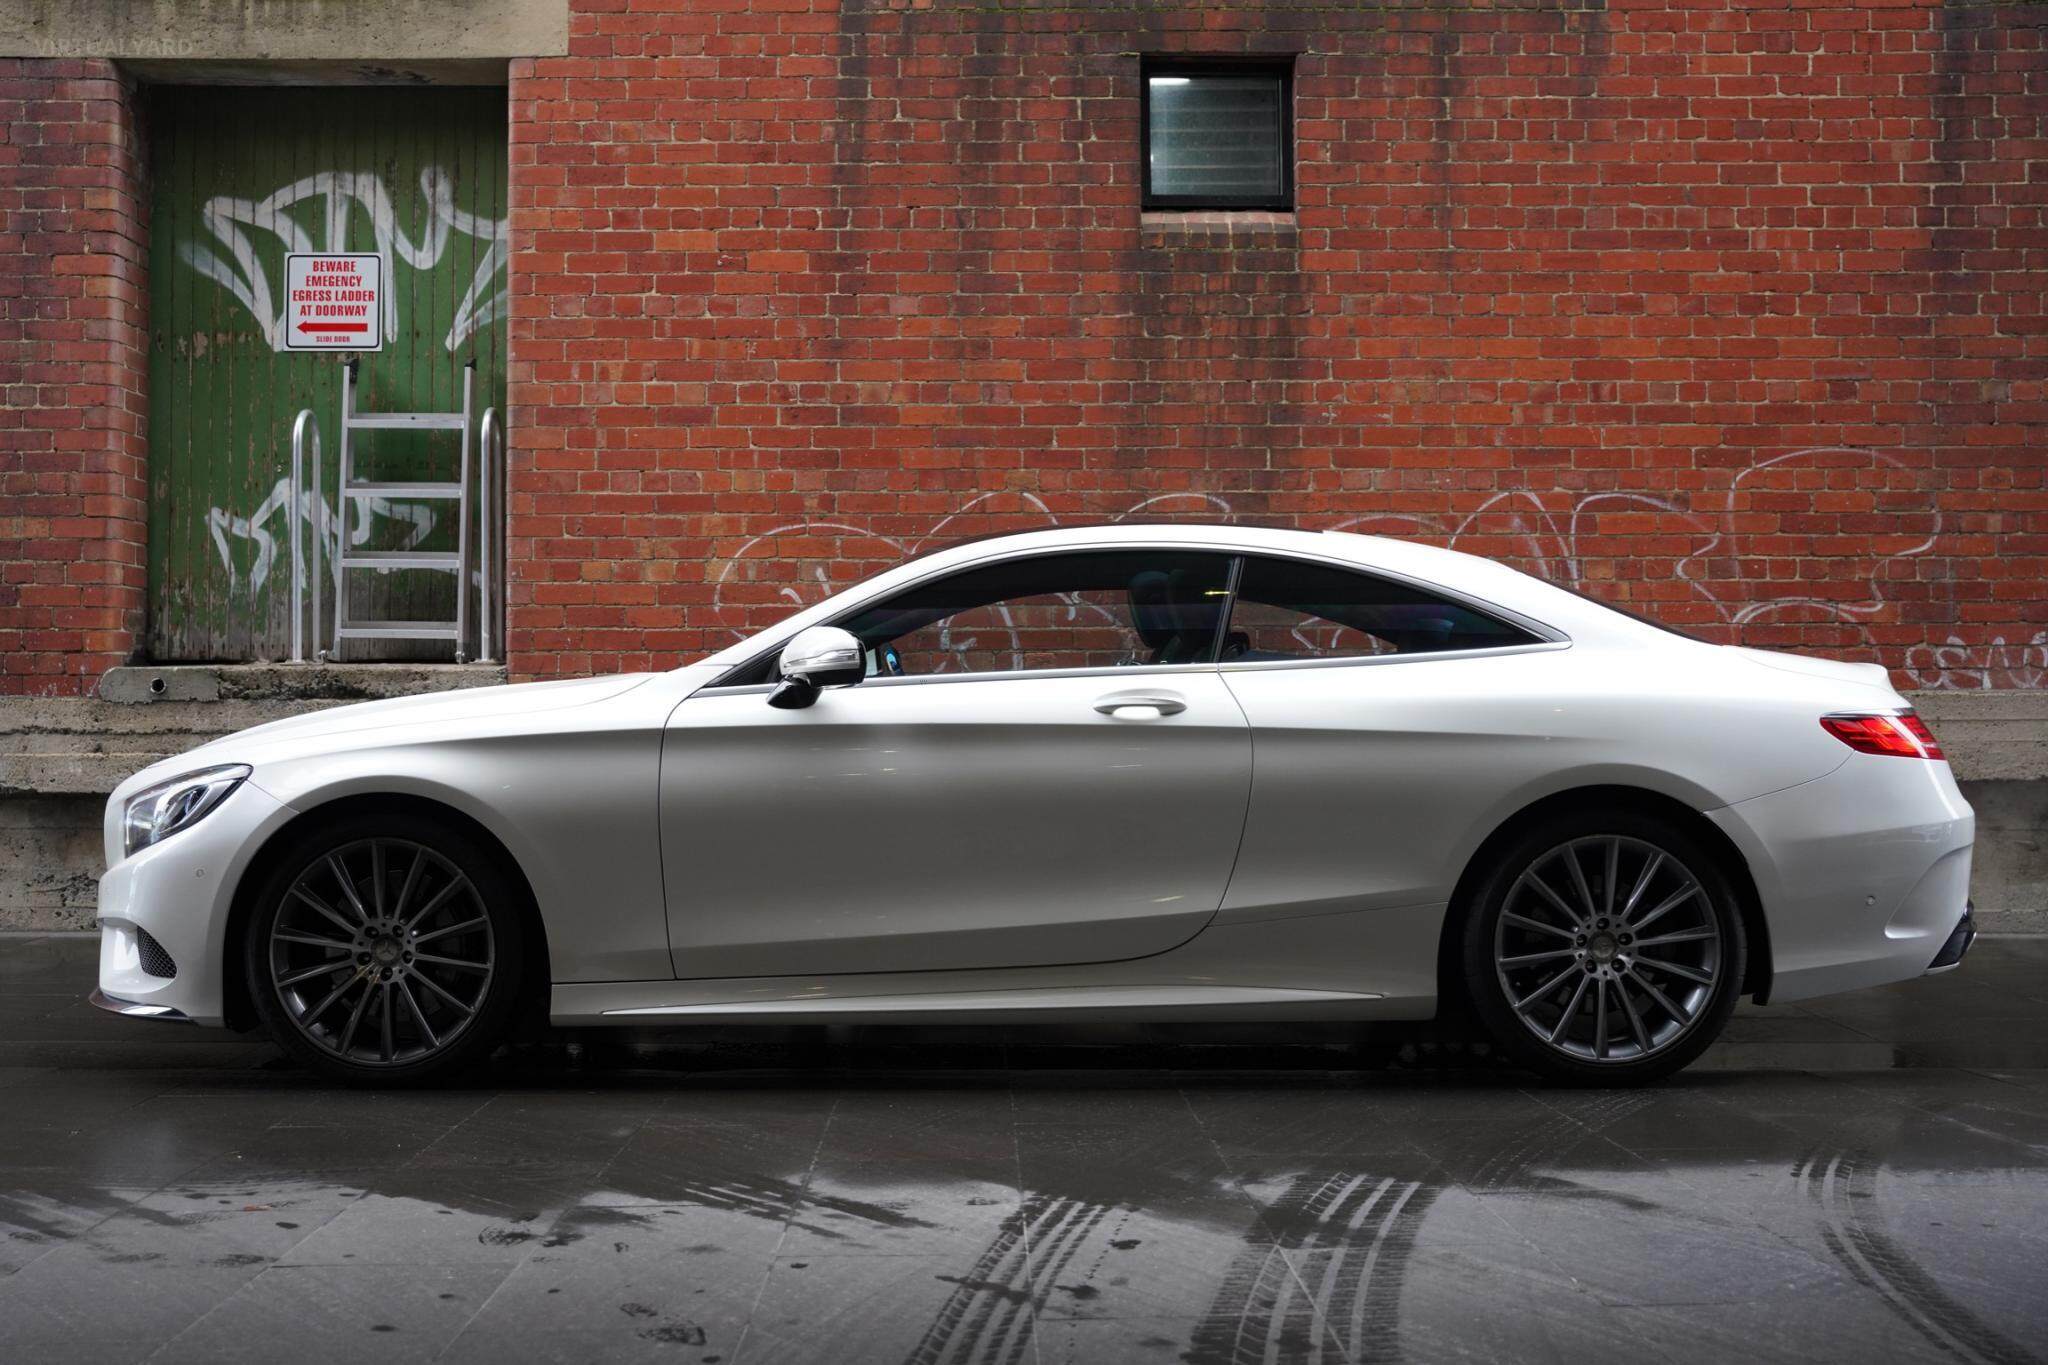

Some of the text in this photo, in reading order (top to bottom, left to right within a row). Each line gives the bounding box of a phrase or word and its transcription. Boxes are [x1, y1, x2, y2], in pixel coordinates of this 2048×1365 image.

[312, 261, 356, 272] BEWARE
[305, 275, 362, 287] EMEGENCY
[292, 290, 375, 302] EGRESS LADDER
[300, 304, 368, 316] AT DOORWAY
